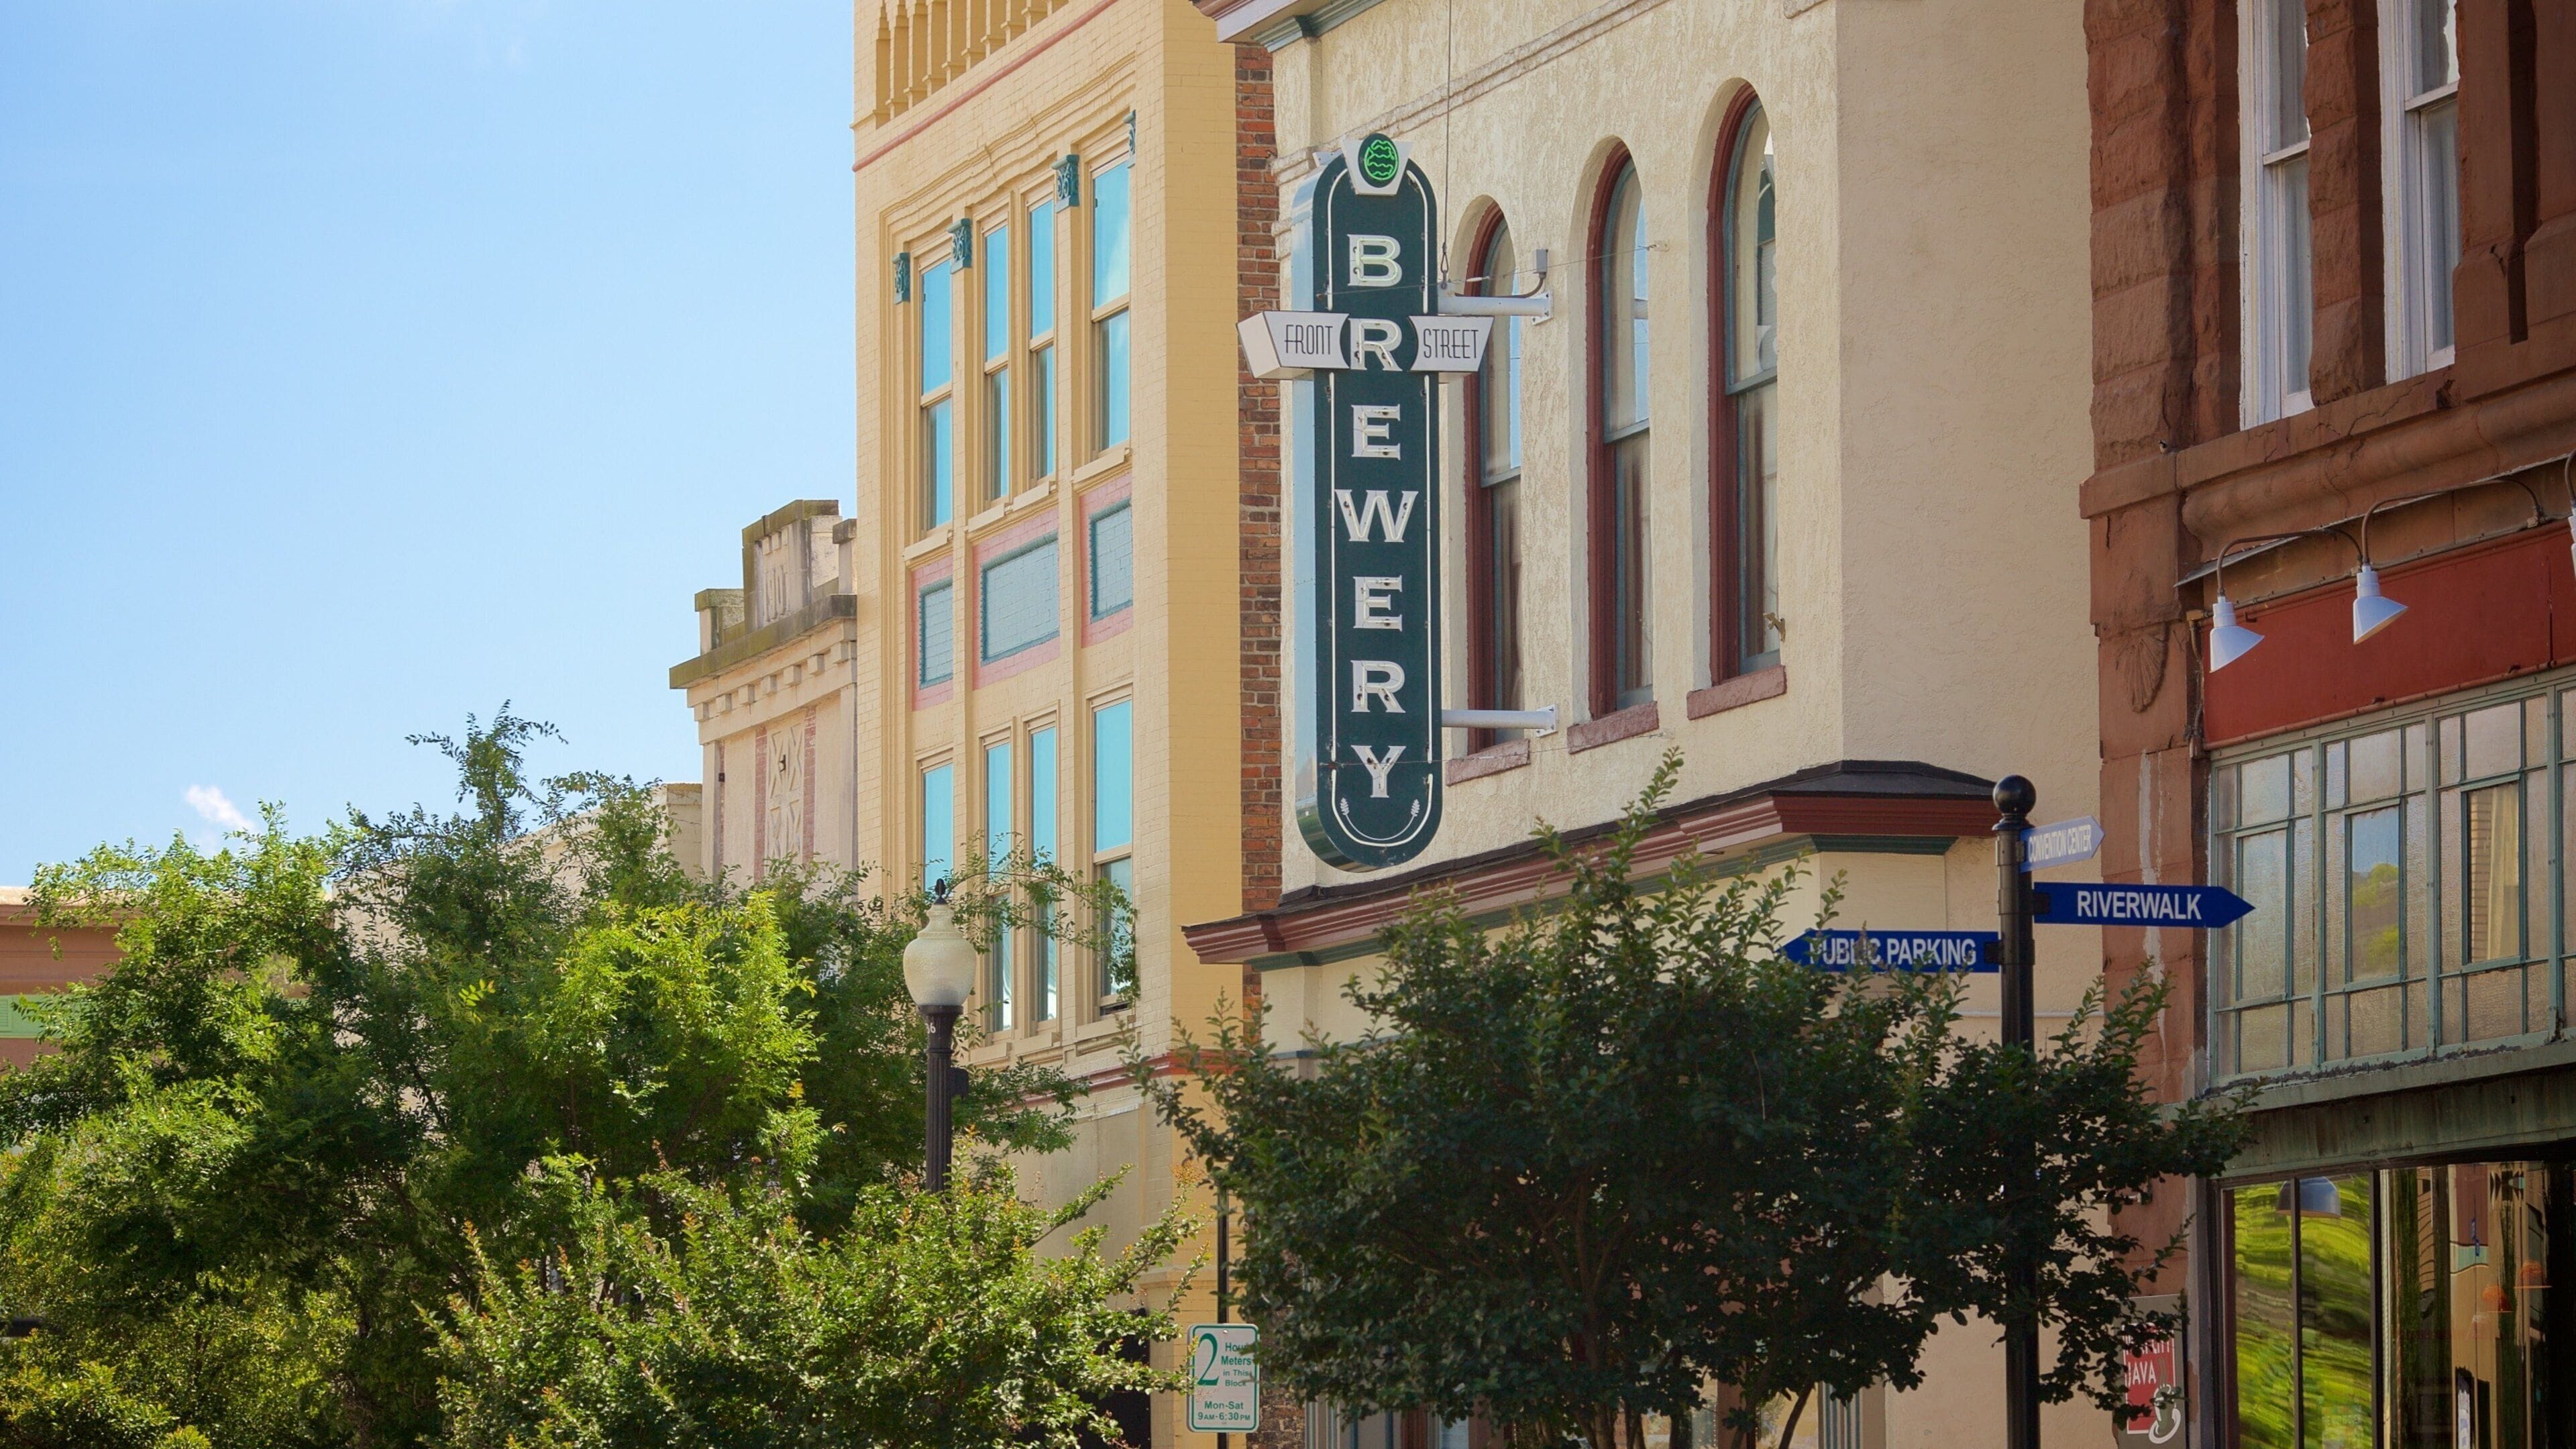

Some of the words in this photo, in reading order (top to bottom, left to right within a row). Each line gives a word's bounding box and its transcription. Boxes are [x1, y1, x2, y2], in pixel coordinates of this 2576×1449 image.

[1285, 325, 1333, 355] FRONT
[1423, 329, 1479, 359] STREET
[1335, 234, 1419, 798] BREWERY
[2028, 829, 2066, 863] CONVENTION
[2068, 824, 2092, 855] CENTER
[2077, 890, 2202, 920] RIVERWALK
[1886, 938, 1977, 965] PARKING
[1197, 1333, 1220, 1386] 2
[1221, 1356, 1252, 1366] Meters
[1225, 1342, 1249, 1352] Hou
[2128, 1360, 2157, 1387] JAVA
[1204, 1401, 1244, 1409] Mon-Sat
